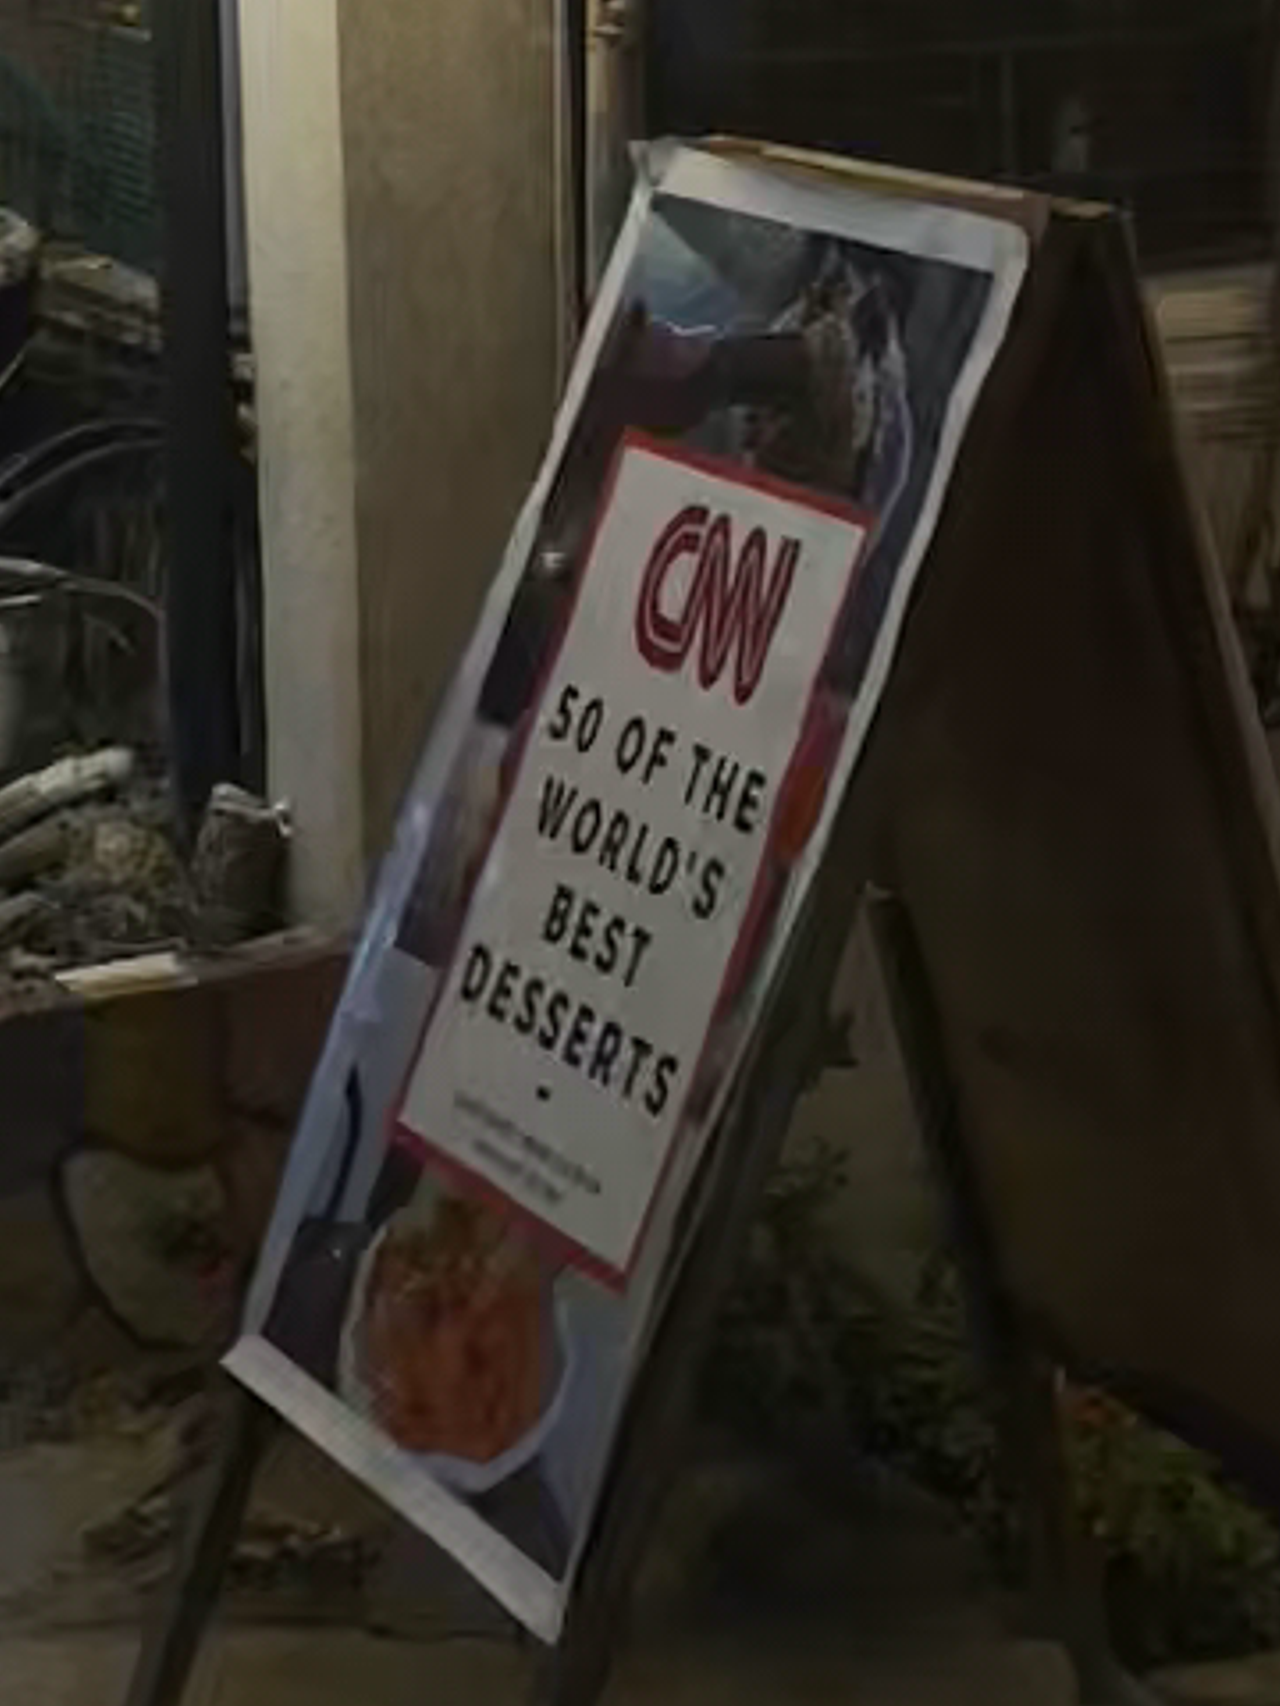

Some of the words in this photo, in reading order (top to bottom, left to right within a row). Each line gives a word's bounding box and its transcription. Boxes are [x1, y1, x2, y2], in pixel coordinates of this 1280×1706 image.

[634, 504, 802, 708] CNN
[548, 684, 605, 755] 50
[615, 715, 677, 786] OF
[682, 744, 768, 834] THE
[536, 774, 726, 921] WORLD'S
[541, 882, 653, 989] BEST
[459, 943, 680, 1119] DESSERTS
